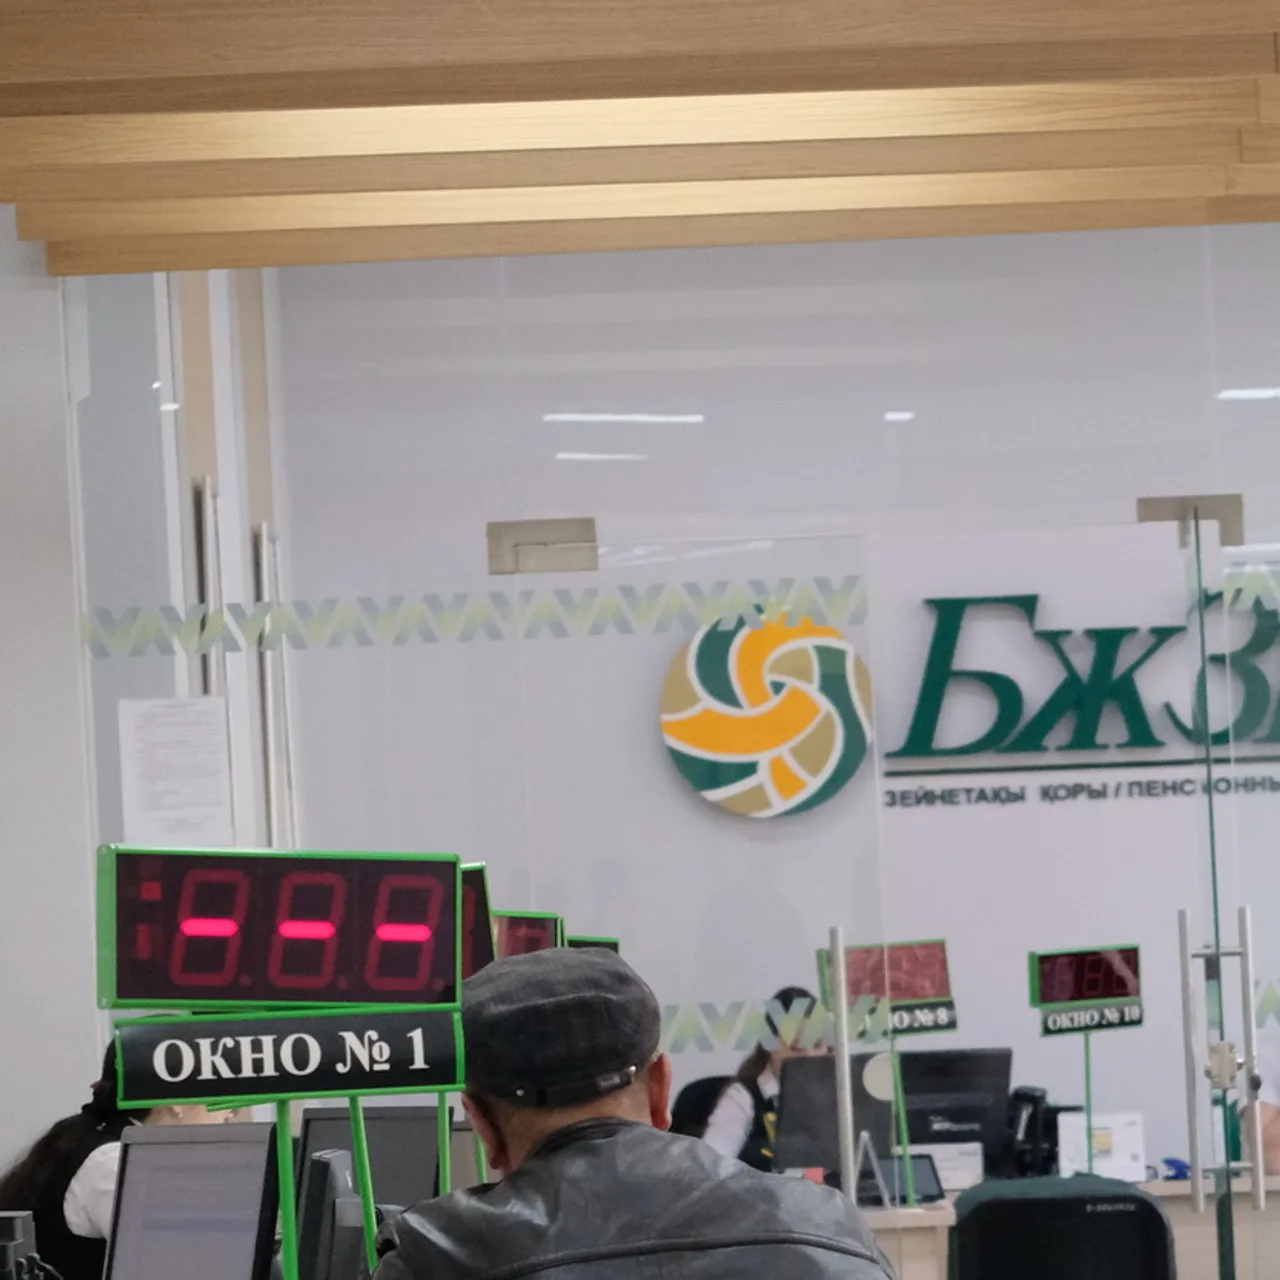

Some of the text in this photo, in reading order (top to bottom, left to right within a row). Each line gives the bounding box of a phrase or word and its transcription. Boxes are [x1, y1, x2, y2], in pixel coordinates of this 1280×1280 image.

[1047, 1009, 1099, 1030] ОКНО
[1101, 1007, 1121, 1025] №
[152, 1027, 430, 1082] ОКНО № 1
